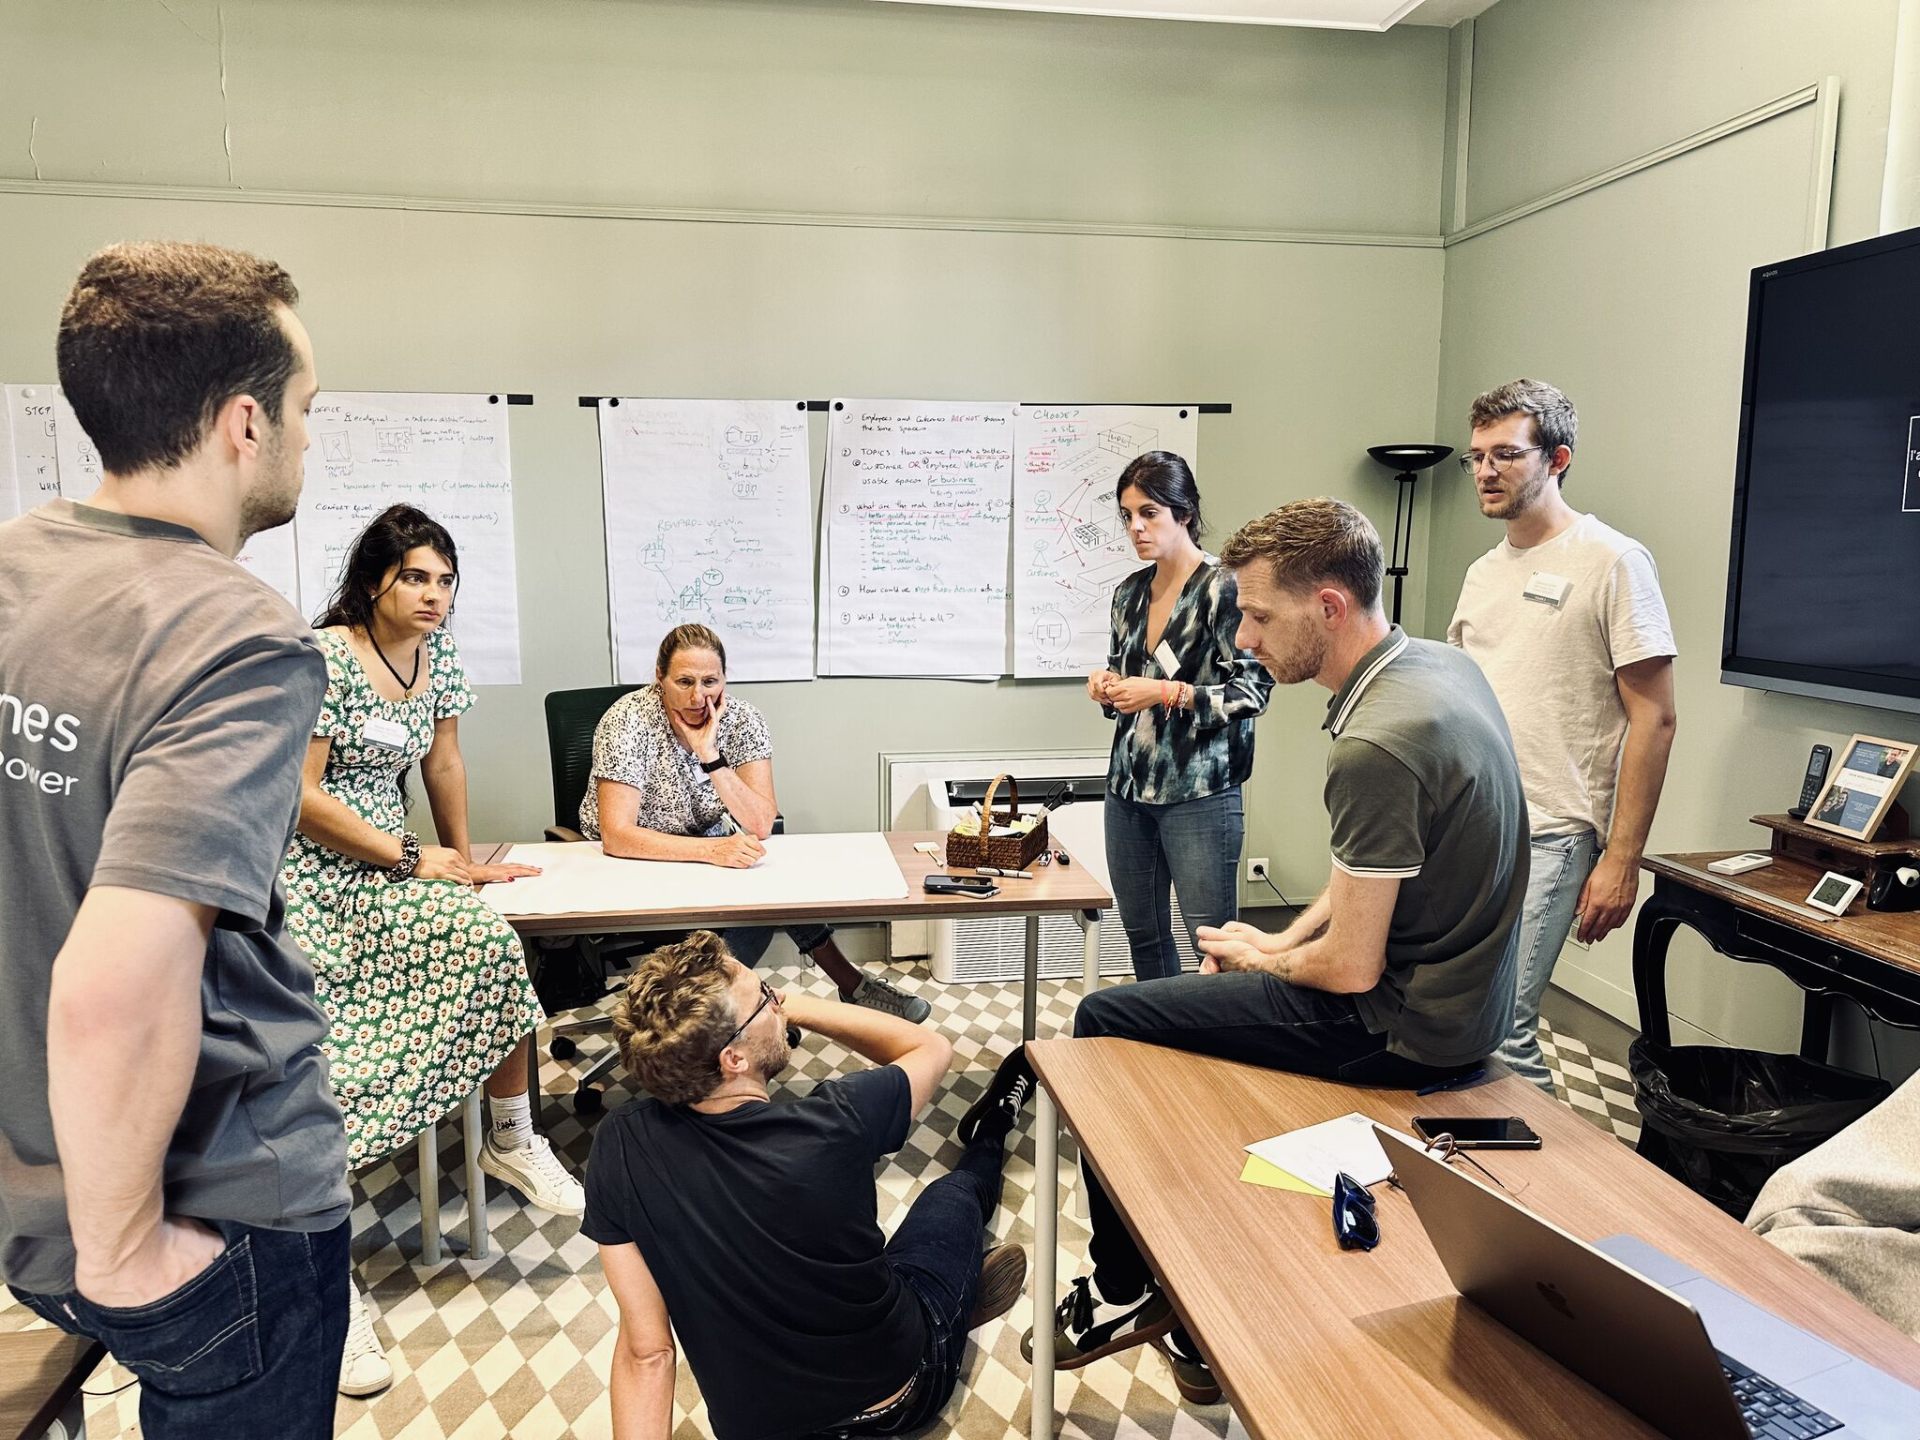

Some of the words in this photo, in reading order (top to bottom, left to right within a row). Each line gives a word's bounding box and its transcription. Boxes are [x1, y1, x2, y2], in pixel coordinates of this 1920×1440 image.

[37, 465, 45, 474] IF
[908, 461, 920, 469] OR
[859, 584, 877, 593] How
[0, 751, 79, 796] ower
